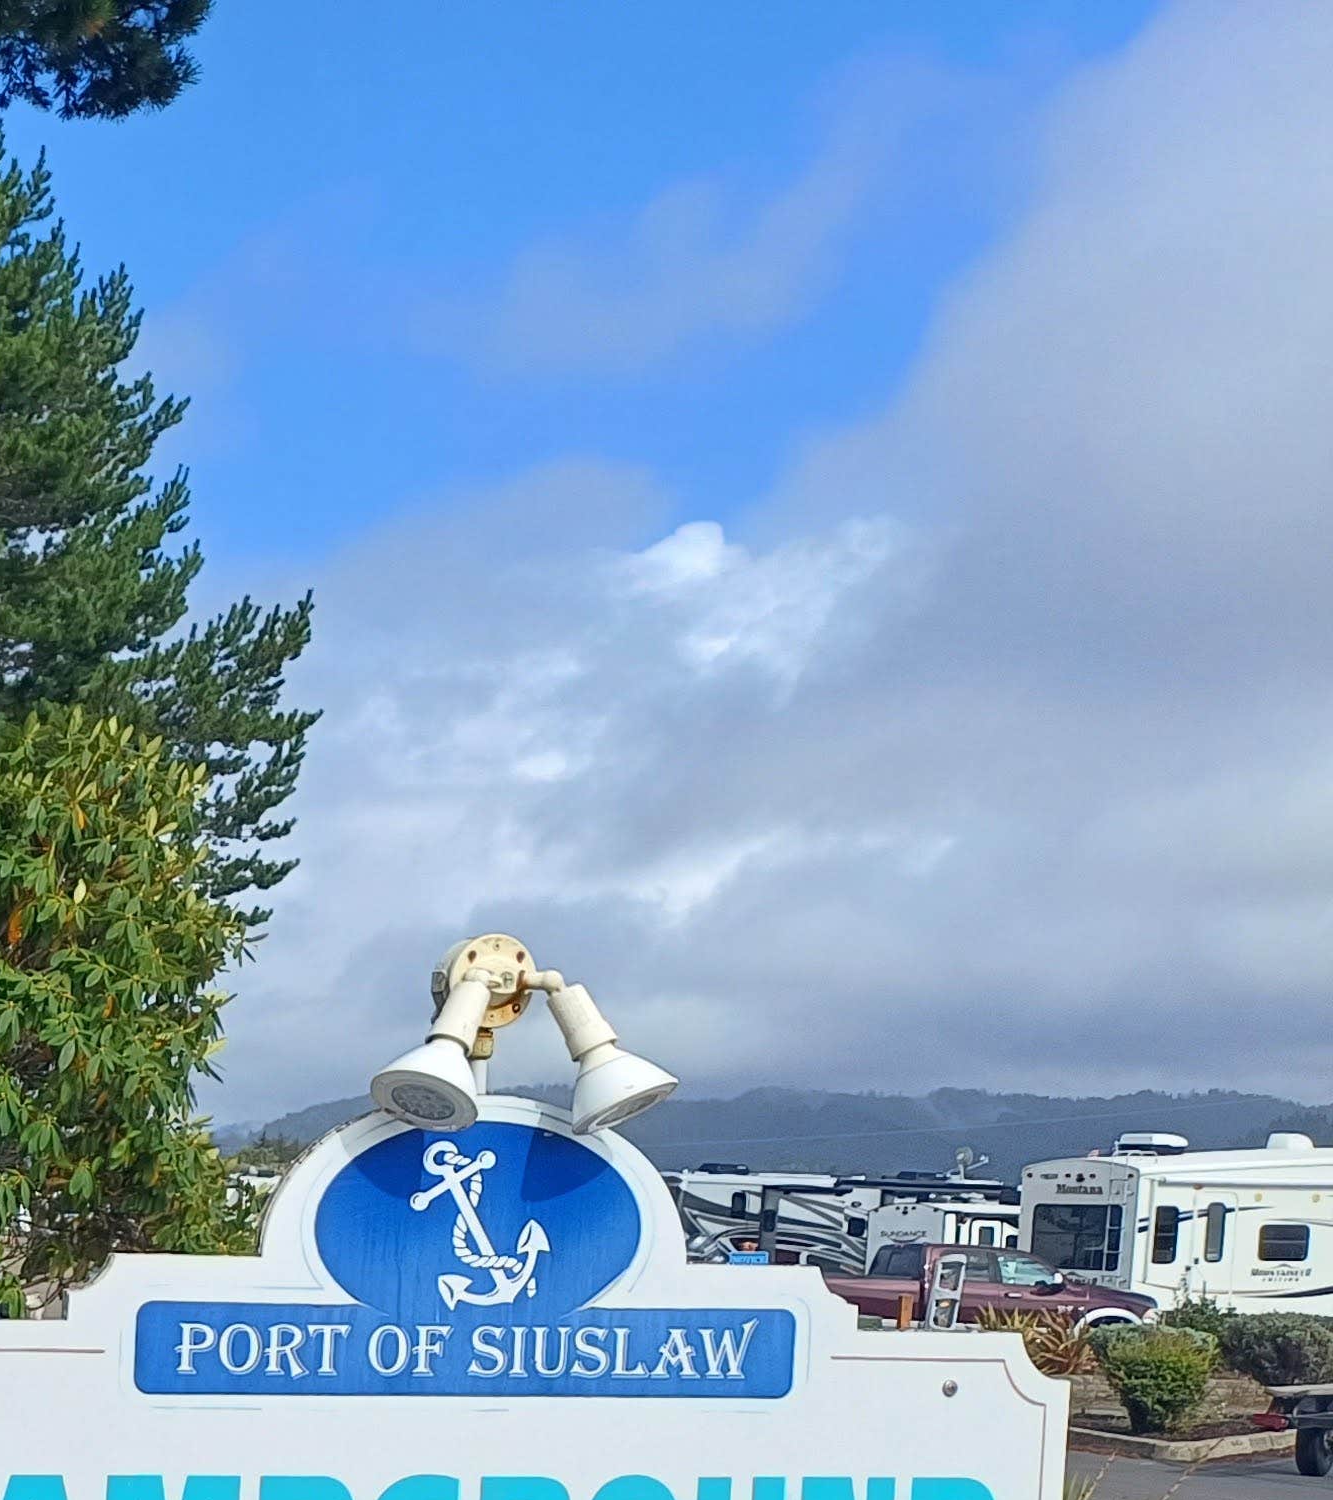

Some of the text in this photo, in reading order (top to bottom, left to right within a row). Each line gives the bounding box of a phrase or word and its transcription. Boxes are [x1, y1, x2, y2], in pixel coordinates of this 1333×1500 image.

[1056, 1184, 1103, 1195] Montana
[880, 1230, 927, 1238] SUNDANCE
[175, 1319, 757, 1378] PORT OF SIUSLAW
